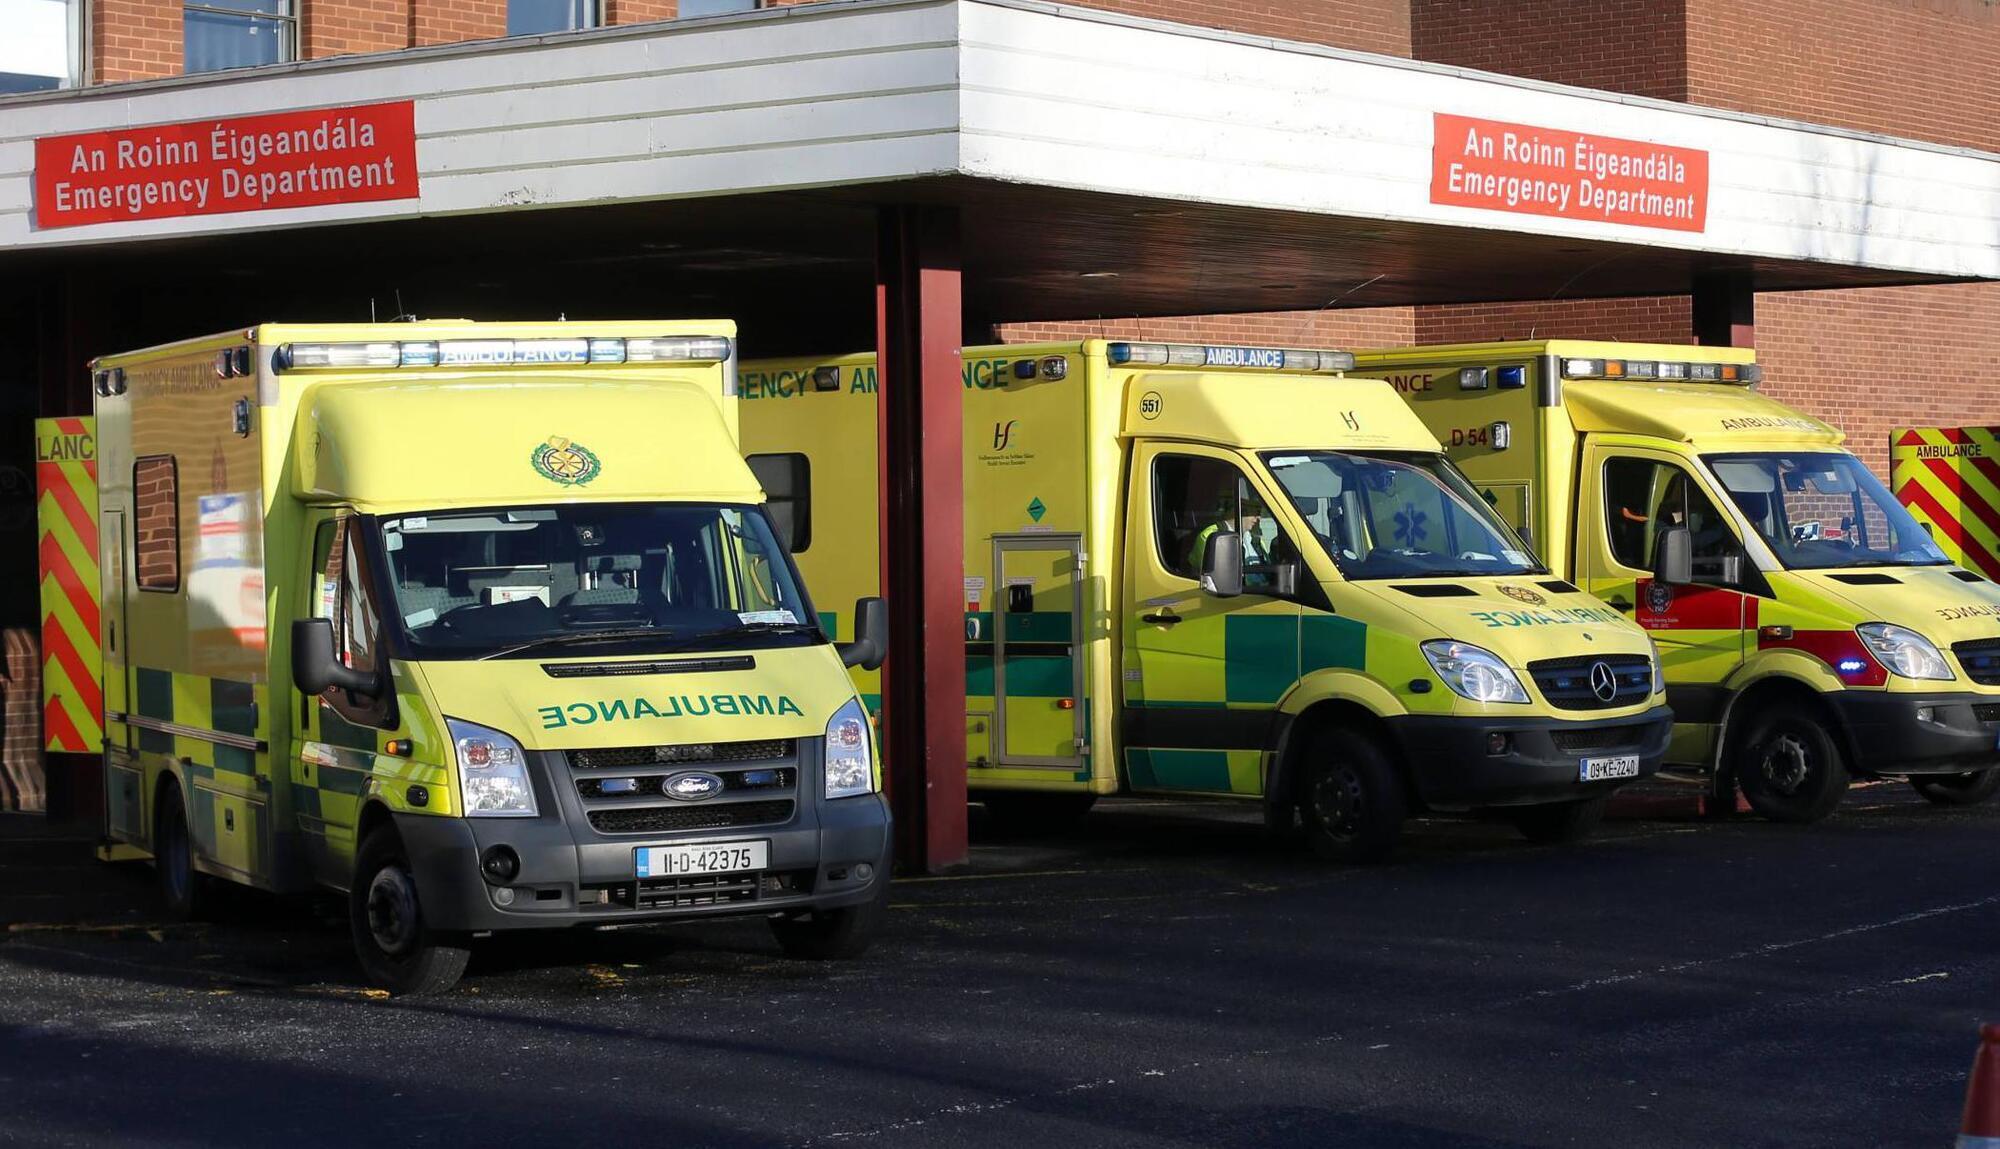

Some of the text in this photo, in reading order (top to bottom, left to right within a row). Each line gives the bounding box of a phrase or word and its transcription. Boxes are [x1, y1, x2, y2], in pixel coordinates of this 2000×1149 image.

[70, 119, 376, 174] An Roinn Éigeandála
[1464, 128, 1685, 183] An Roinn Éigeandála
[55, 154, 395, 213] Emergency Department
[1449, 164, 1694, 219] Emergency Department
[1207, 348, 1280, 367] AMBULANCE
[1142, 400, 1160, 412] 551
[37, 434, 94, 460] LANC
[1452, 428, 1487, 446] D 54
[1916, 444, 1982, 458] AMBULANCE
[1590, 760, 1634, 778] 09-KE-2240
[677, 778, 710, 792] Ford
[664, 848, 751, 873] 11-D-42375
